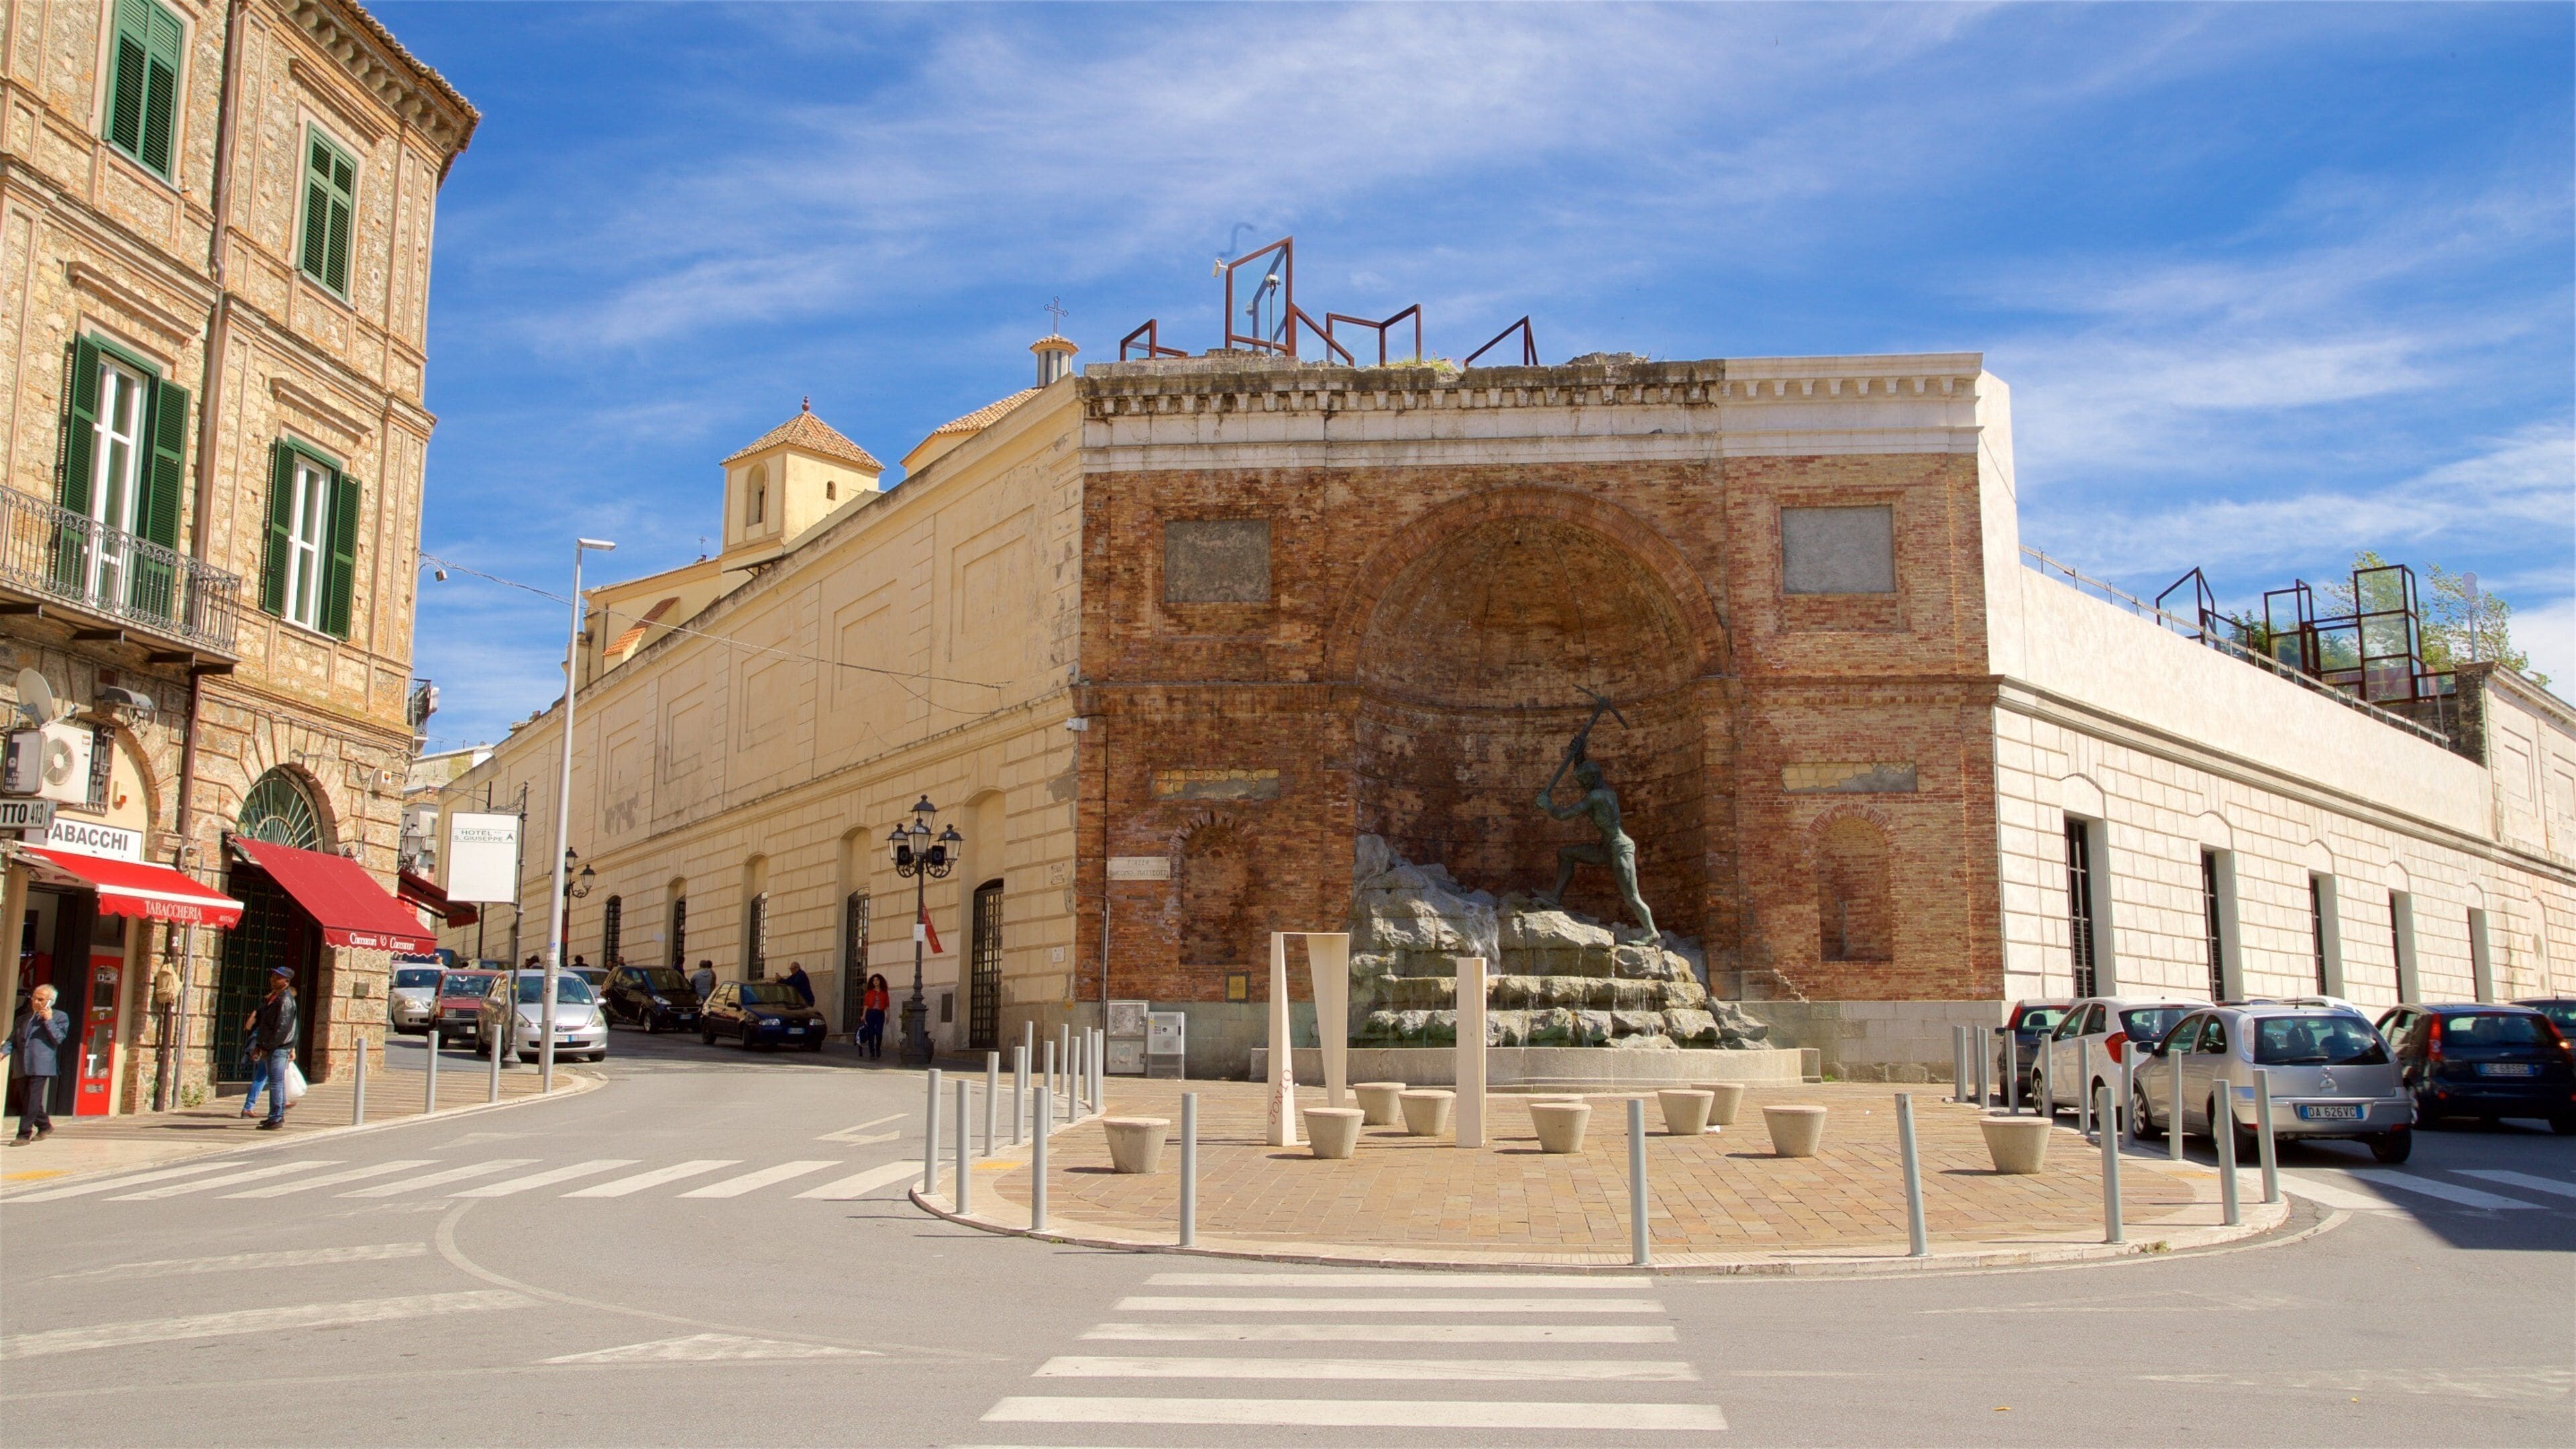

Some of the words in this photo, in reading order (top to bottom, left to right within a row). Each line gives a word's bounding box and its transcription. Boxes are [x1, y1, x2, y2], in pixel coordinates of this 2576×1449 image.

[0, 804, 28, 824] TTO
[30, 804, 44, 824] 413
[52, 823, 128, 851] ABACCHI
[145, 900, 202, 920] TABACCHERIA
[1269, 1069, 1293, 1124] JONIO
[2308, 1107, 2321, 1117] DA
[2324, 1107, 2356, 1117] 626VC
